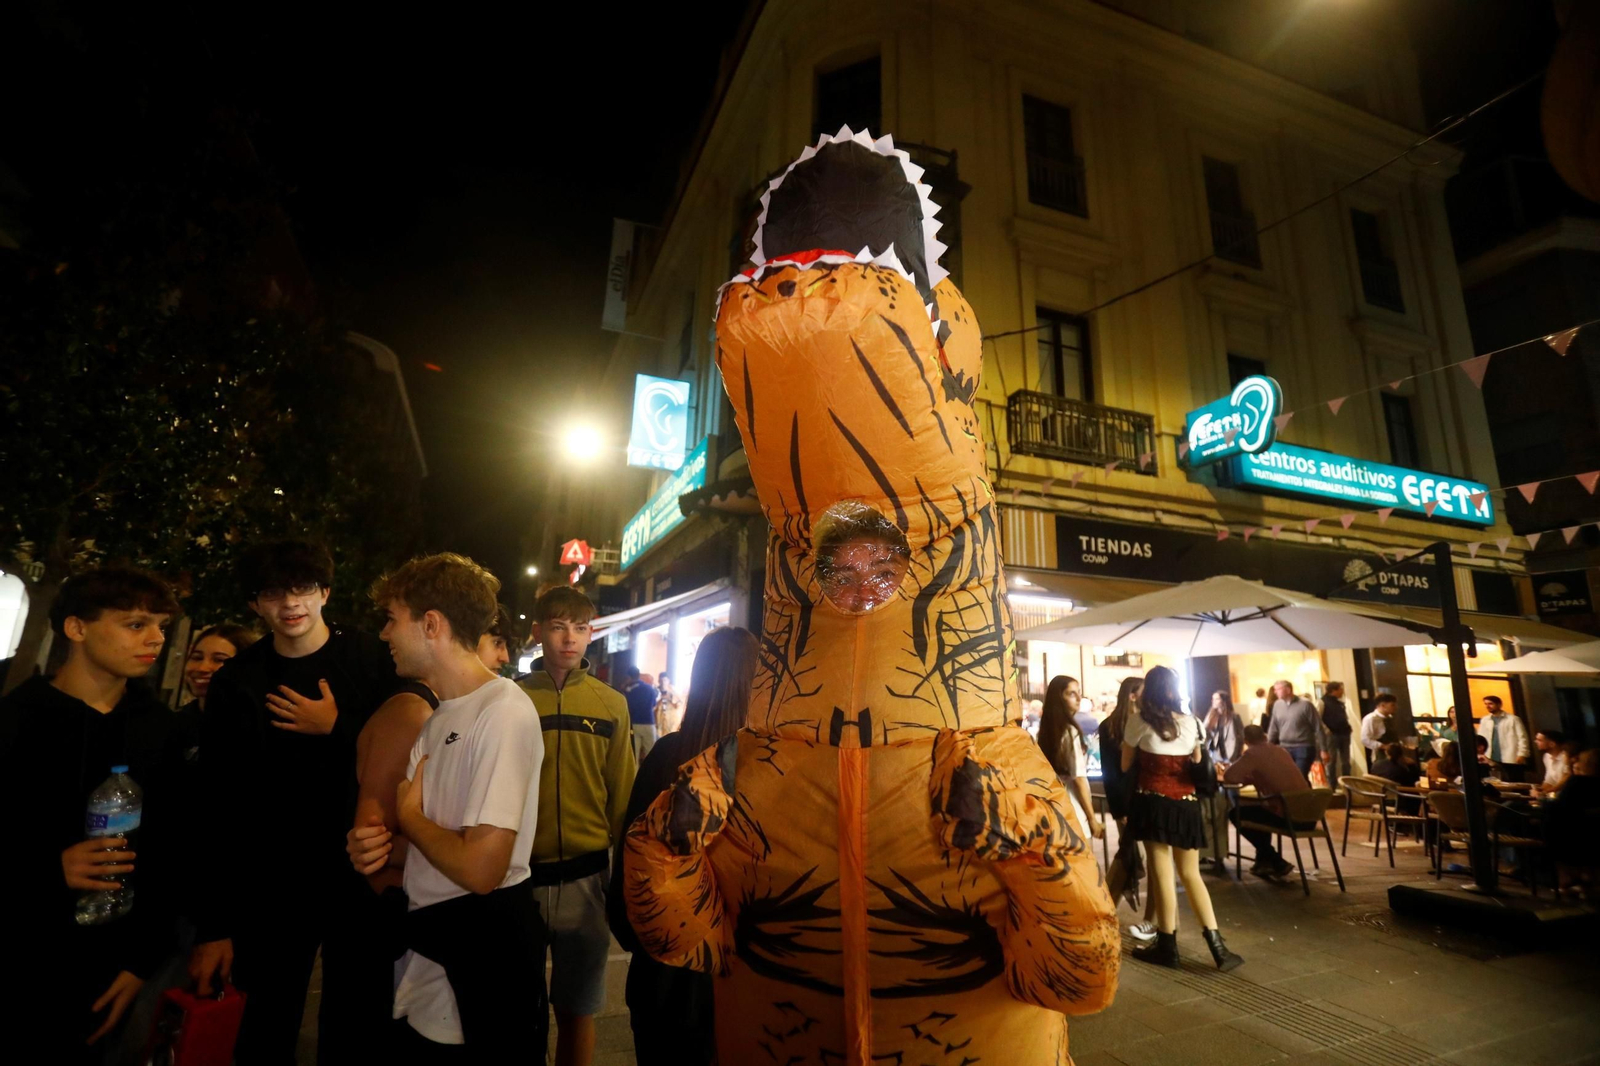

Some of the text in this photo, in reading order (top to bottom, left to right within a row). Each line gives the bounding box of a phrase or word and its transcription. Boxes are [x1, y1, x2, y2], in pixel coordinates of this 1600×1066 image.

[1320, 461, 1397, 490] auditivos
[1402, 474, 1490, 518] EFETA
[1079, 535, 1153, 558] TIENDAS
[1379, 571, 1429, 589] D'TAPAS
